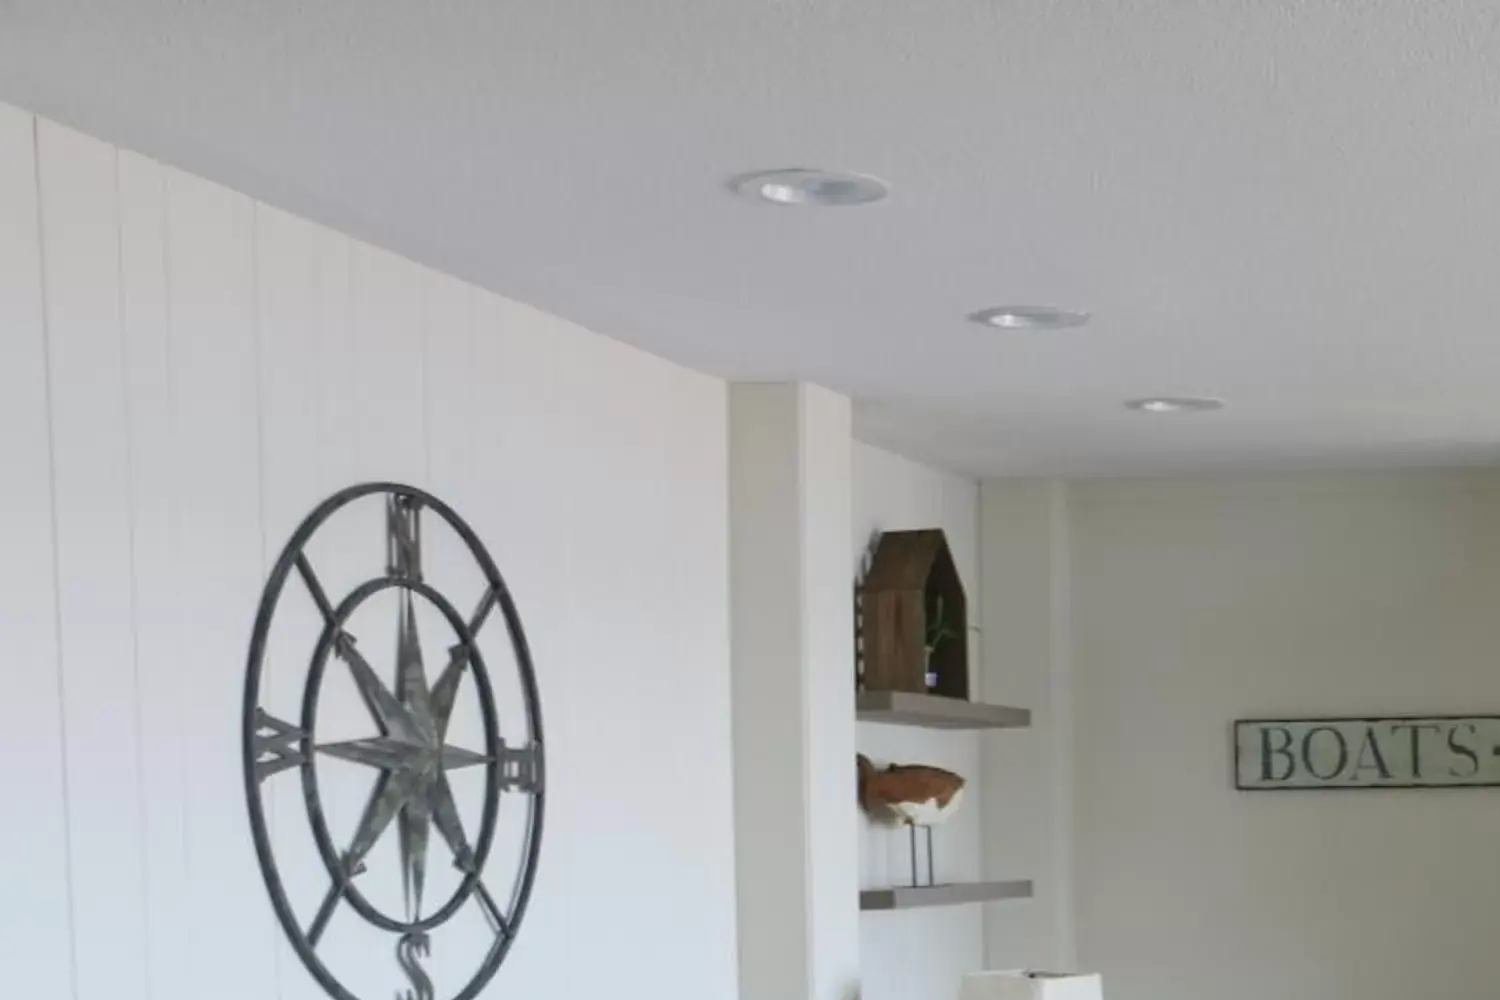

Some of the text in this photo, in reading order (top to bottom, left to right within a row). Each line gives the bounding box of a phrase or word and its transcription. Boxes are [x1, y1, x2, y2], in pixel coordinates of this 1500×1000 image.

[385, 491, 424, 581] N
[254, 706, 306, 784] W
[497, 736, 544, 793] E
[1258, 724, 1479, 782] BOATS
